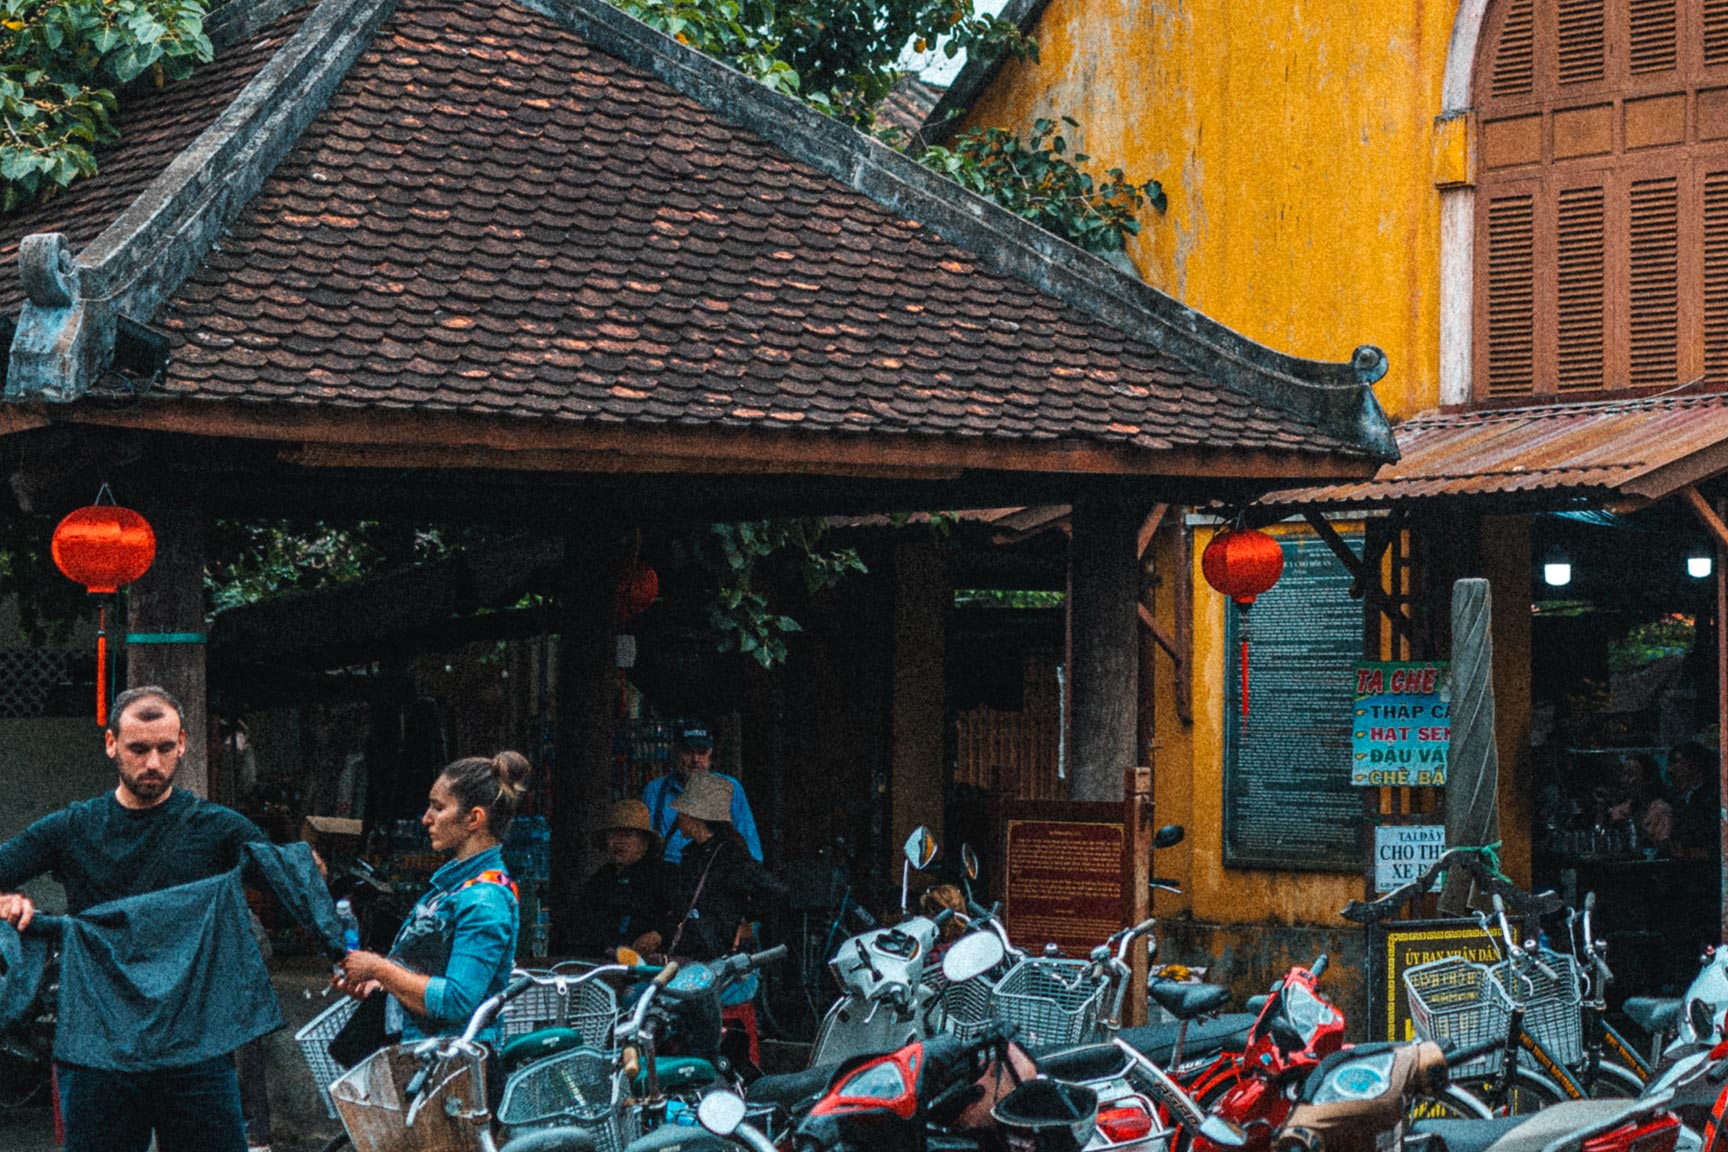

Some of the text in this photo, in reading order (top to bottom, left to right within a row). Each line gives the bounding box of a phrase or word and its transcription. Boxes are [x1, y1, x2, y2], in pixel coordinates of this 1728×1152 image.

[1389, 663, 1438, 694] CHÈ
[1370, 702, 1424, 722] THẬP
[1369, 727, 1411, 744] HẠT
[1370, 745, 1411, 766] ĐẬU
[1380, 844, 1414, 861] CHO
[1392, 863, 1413, 879] XE
[1422, 949, 1445, 964] BAN
